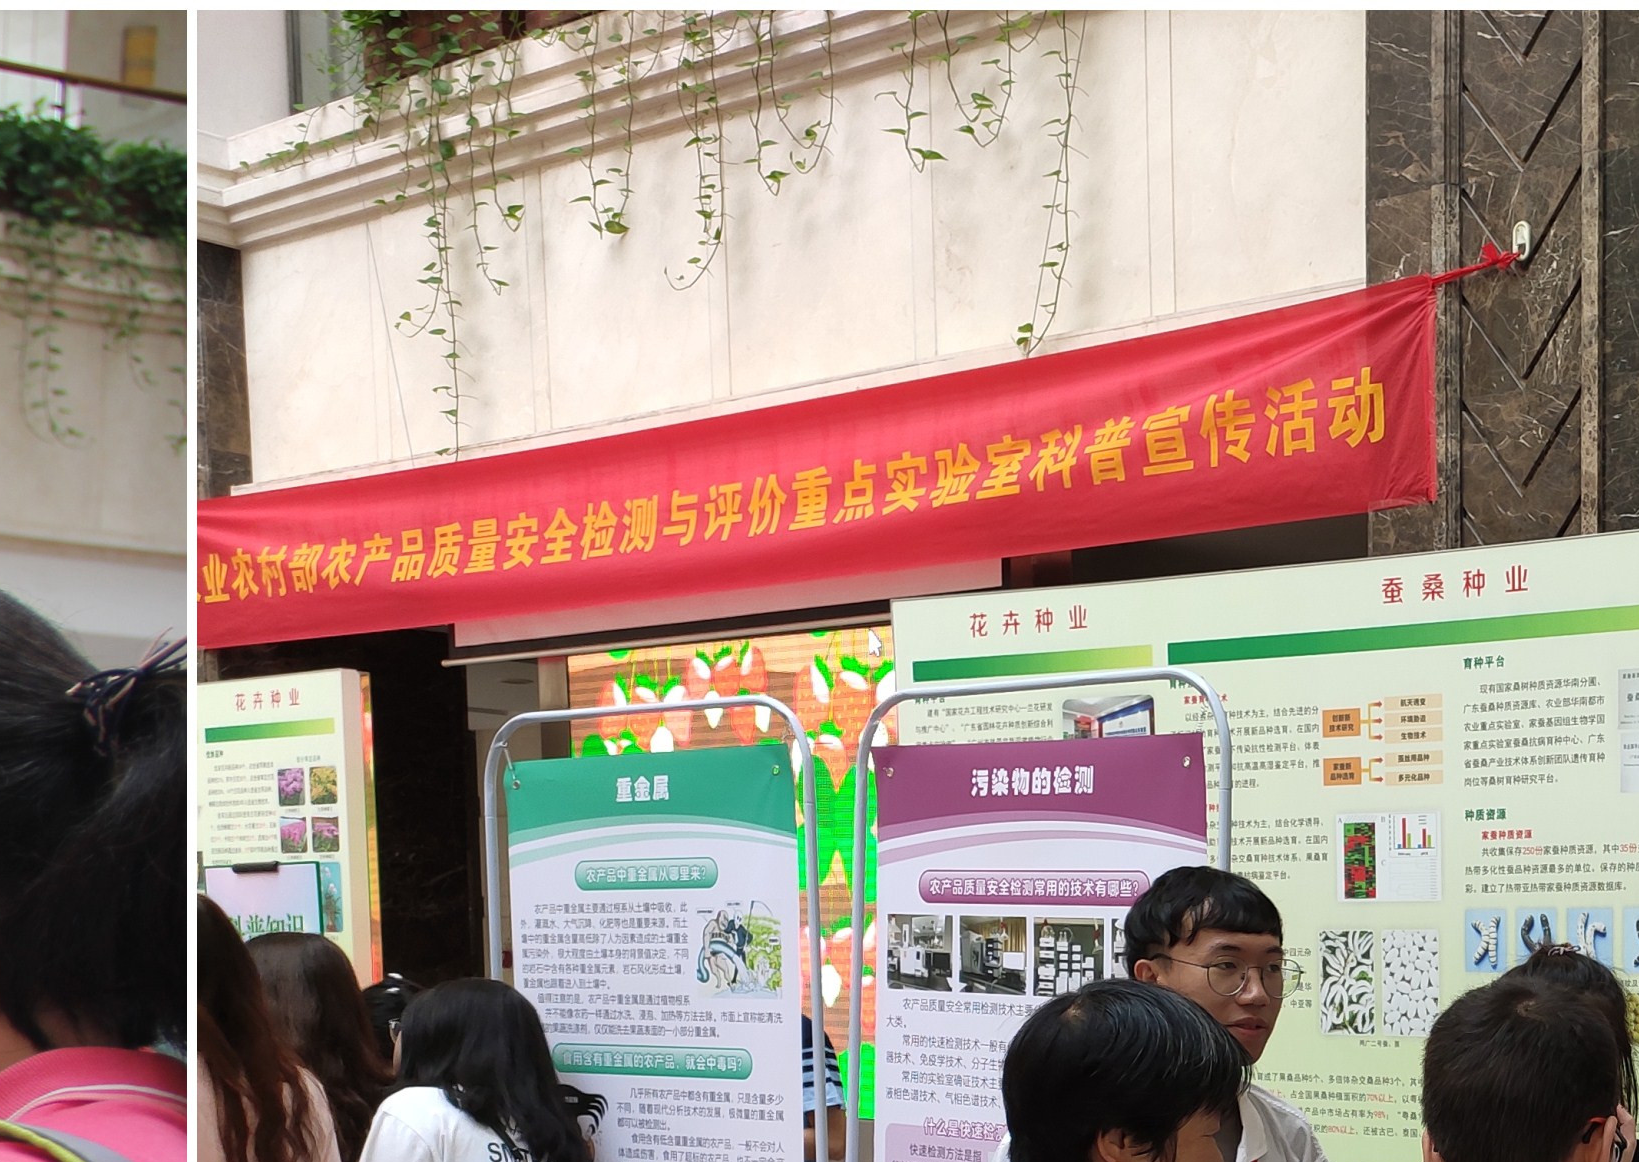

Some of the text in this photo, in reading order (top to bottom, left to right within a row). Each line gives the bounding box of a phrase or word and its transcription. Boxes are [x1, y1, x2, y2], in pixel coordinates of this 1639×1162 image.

[199, 365, 1386, 604] 业农村部农产品质量安全检测与评价重点实验室科普宣传活动
[1381, 564, 1532, 606] 蚕桑种业
[968, 602, 1089, 640] 花卉种业
[1463, 655, 1506, 670] 育种平台
[235, 687, 300, 712] 花卉种业
[615, 775, 670, 802] 重金属
[970, 765, 1095, 797] 污染物的检测
[1464, 808, 1507, 822] 种质资源
